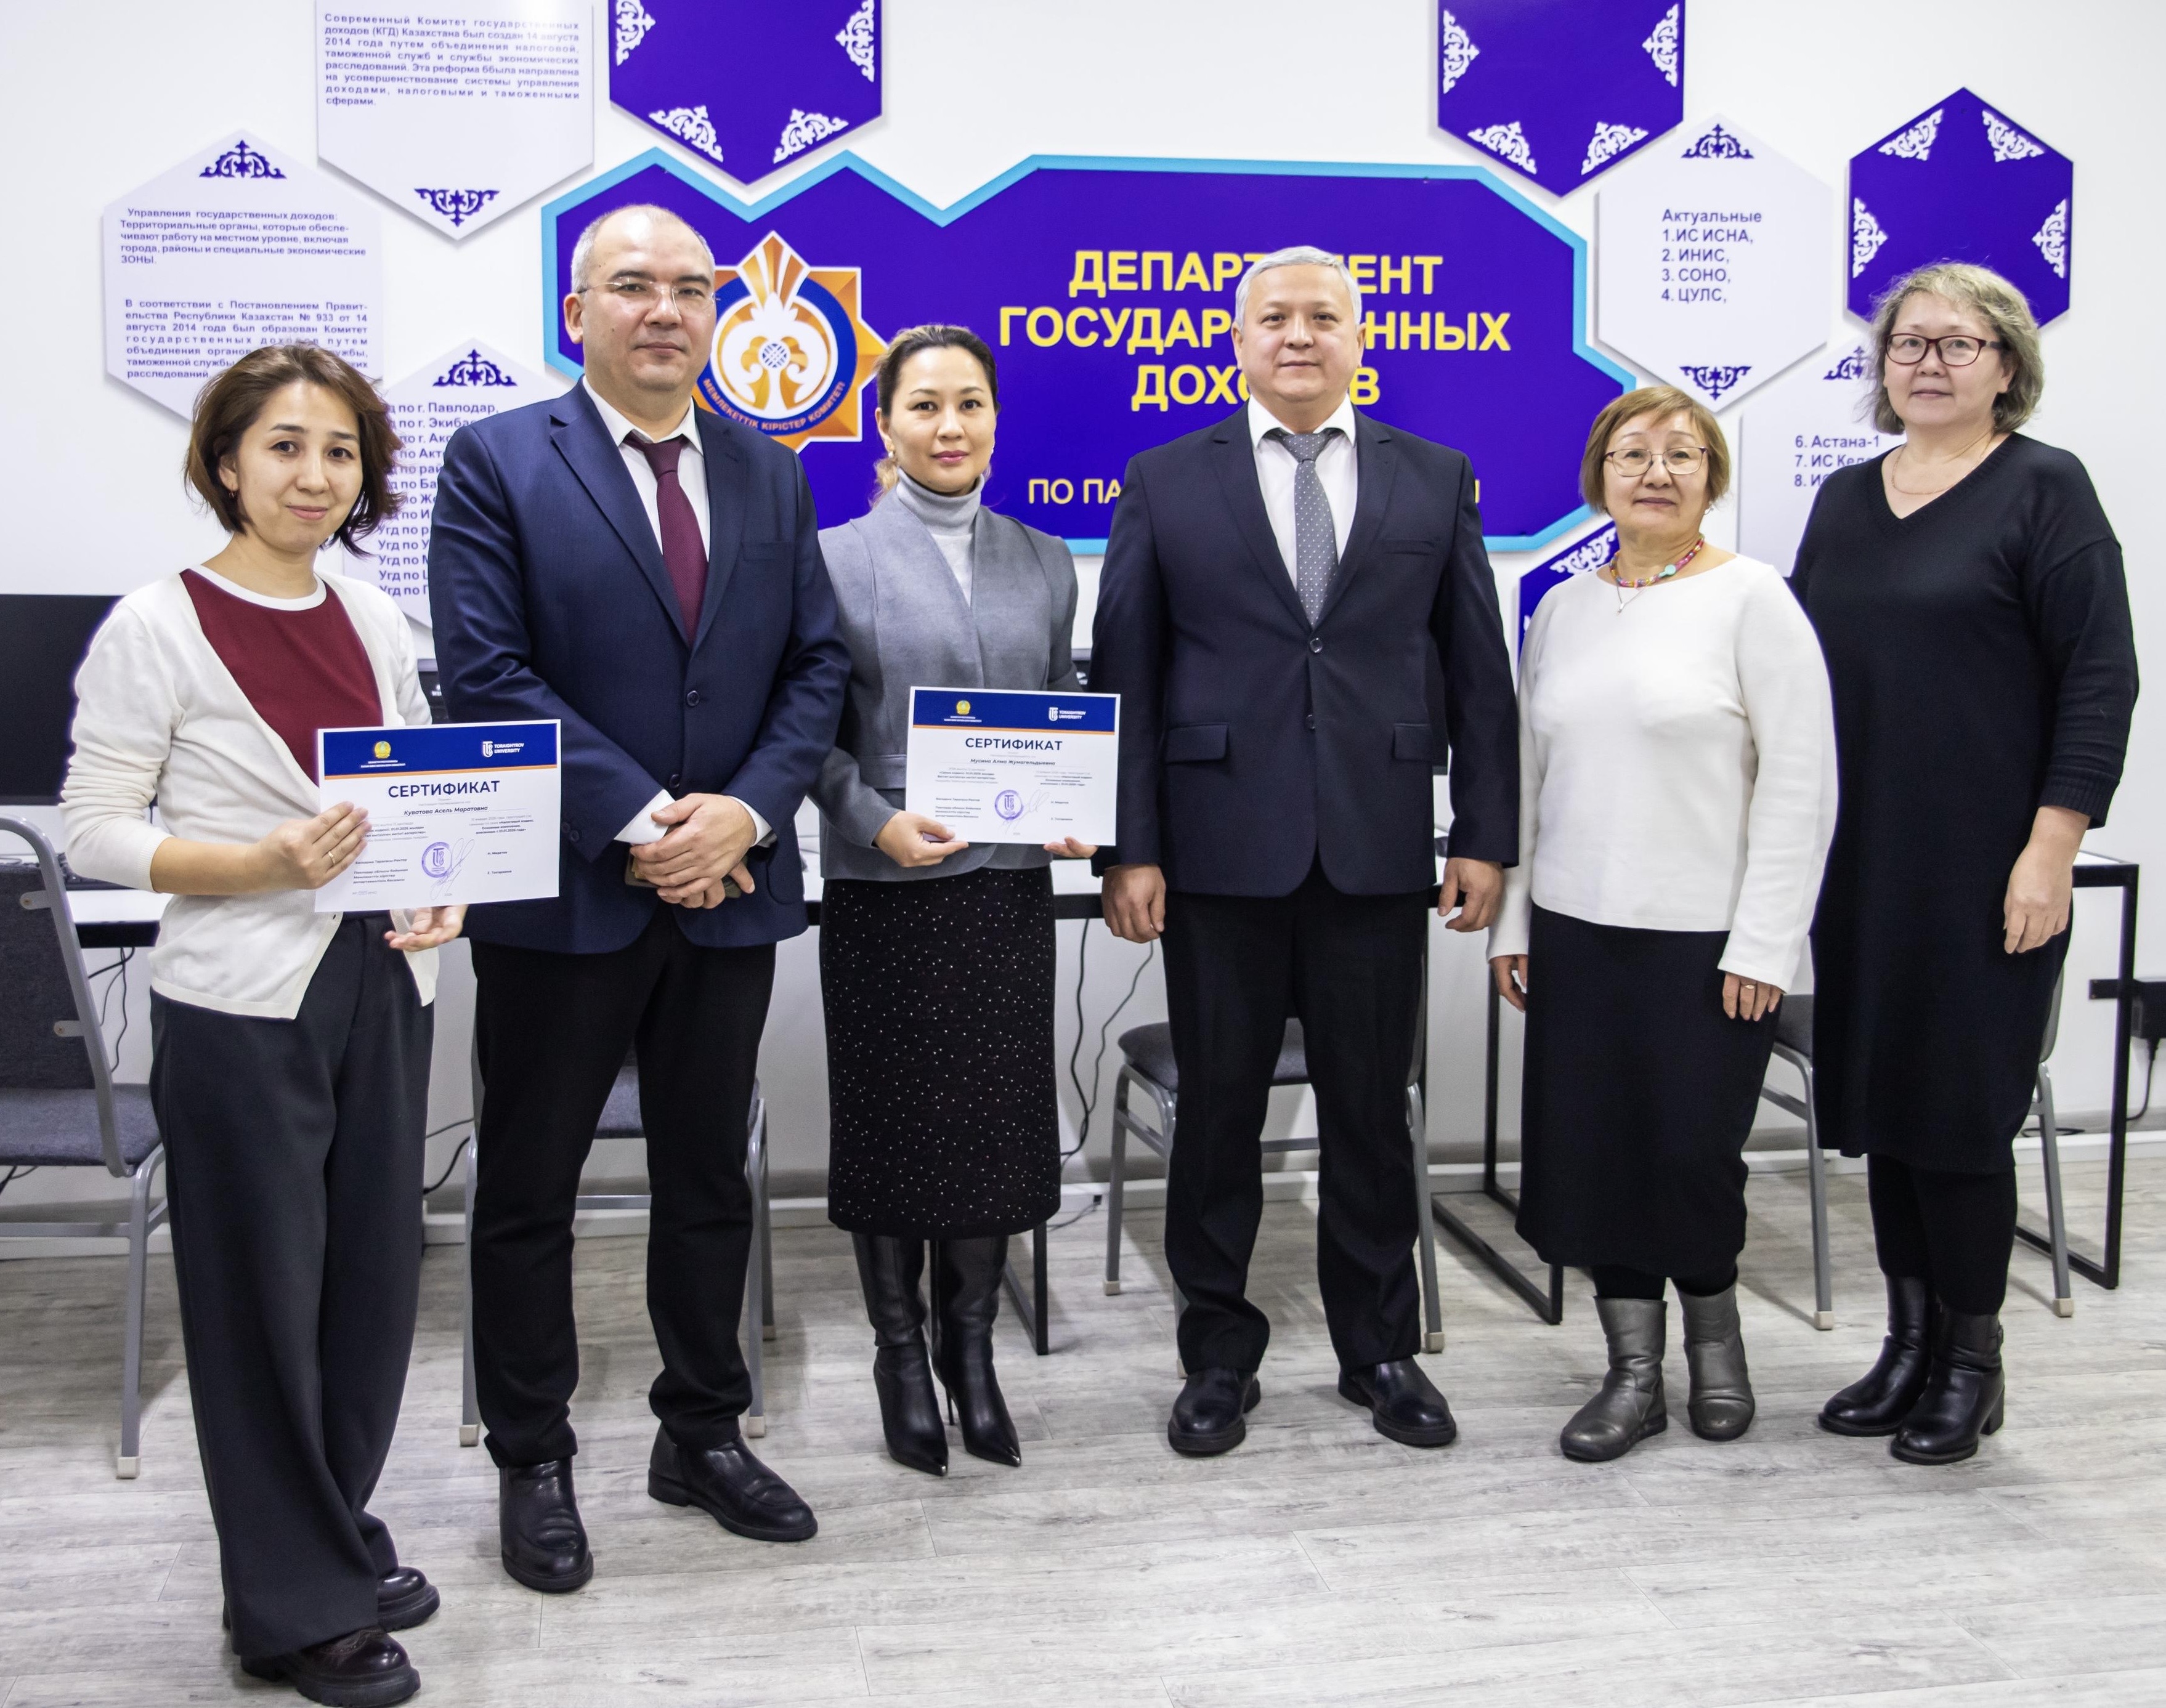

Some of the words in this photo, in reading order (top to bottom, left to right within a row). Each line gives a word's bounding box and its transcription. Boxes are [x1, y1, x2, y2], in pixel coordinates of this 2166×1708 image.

[325, 14, 410, 24] Современный
[418, 17, 466, 26] Комитет
[325, 26, 369, 34] доходов
[373, 27, 399, 37] (КГД)
[402, 28, 460, 38] Казахстана
[463, 30, 485, 38] был
[487, 31, 523, 40] создан
[541, 34, 579, 42] августа
[325, 38, 351, 46] 2014
[358, 39, 383, 48] года
[391, 41, 424, 50] путем
[431, 41, 509, 51] объединения
[516, 44, 579, 54] налоговой,
[326, 50, 391, 59] таможенной
[398, 52, 431, 62] служб
[450, 54, 492, 63] службы
[499, 56, 579, 64] экономических
[325, 62, 409, 71] расследований.
[412, 64, 430, 72] Эта
[433, 65, 480, 74] реформа
[482, 65, 516, 74] ббыла
[518, 68, 579, 76] направлена
[344, 75, 458, 85] усовершенствование
[517, 80, 579, 88] управления
[325, 86, 390, 95] доходами,
[495, 90, 580, 99] таможенными
[326, 97, 376, 107] сферами.
[128, 208, 191, 218] Управления
[196, 211, 288, 219] государственных
[1662, 208, 1762, 226] Актуальные
[121, 220, 217, 230] Территориальные
[219, 224, 261, 232] органы,
[262, 224, 306, 232] которые
[309, 224, 349, 232] обеспе-
[161, 233, 198, 242] работу
[262, 236, 302, 244] уровне,
[1703, 229, 1753, 245] ИСНА,
[162, 244, 203, 254] районы
[214, 246, 285, 254] специальные
[287, 248, 367, 256] экономические
[1662, 248, 1674, 262] 2.
[1679, 248, 1729, 264] ИНИС,
[121, 255, 157, 264] ЗОНЫ.
[1068, 249, 1443, 297] ДЕПАРЕНТ
[1662, 268, 1674, 281] 3.
[1679, 268, 1730, 284] СОНО,
[1661, 288, 1674, 301] 4.
[1679, 288, 1726, 304] ЦУЛС,
[126, 299, 132, 307] В
[230, 301, 320, 310] Постановлением
[326, 302, 368, 311] Правит-
[174, 312, 236, 322] Республики
[241, 312, 294, 322] Казахстан
[299, 313, 310, 321] №
[316, 314, 334, 322] 933
[357, 314, 367, 322] 14
[126, 325, 166, 333] августа
[172, 323, 196, 331] 2014
[203, 325, 226, 333] года
[261, 324, 318, 334] образован
[324, 325, 367, 333] Комитет
[999, 306, 1512, 355] ГОСУДАРННЫХ
[126, 336, 251, 344] государственных
[260, 336, 318, 345] дохов
[328, 338, 368, 346] путем
[127, 346, 201, 355] объединения
[127, 358, 191, 366] таможенной
[193, 358, 235, 368] службы
[1131, 363, 1381, 412] ДОХВ
[399, 405, 415, 413] по
[428, 402, 499, 415] Павлодар,
[399, 420, 415, 428] по
[418, 420, 426, 428] г.
[400, 435, 416, 443] по
[1795, 435, 1807, 448] 6.
[1811, 435, 1879, 448] Астана-1
[1795, 454, 1807, 467] 7.
[1811, 454, 1833, 467] ИС
[400, 466, 416, 474] по
[401, 481, 417, 489] по
[1794, 474, 1807, 487] 8.
[1029, 478, 1074, 504] ПО
[402, 512, 418, 520] по
[402, 527, 418, 535] по
[378, 540, 400, 551] Угд
[403, 542, 419, 550] по
[379, 555, 400, 567] Угд
[404, 557, 420, 565] по
[379, 570, 401, 582] Угд
[404, 572, 420, 580] по
[379, 585, 402, 597] Угд
[404, 587, 420, 596] по
[965, 737, 1063, 751] СЕРТИФИКАТ
[387, 780, 500, 798] СЕРТИФИКАТ
